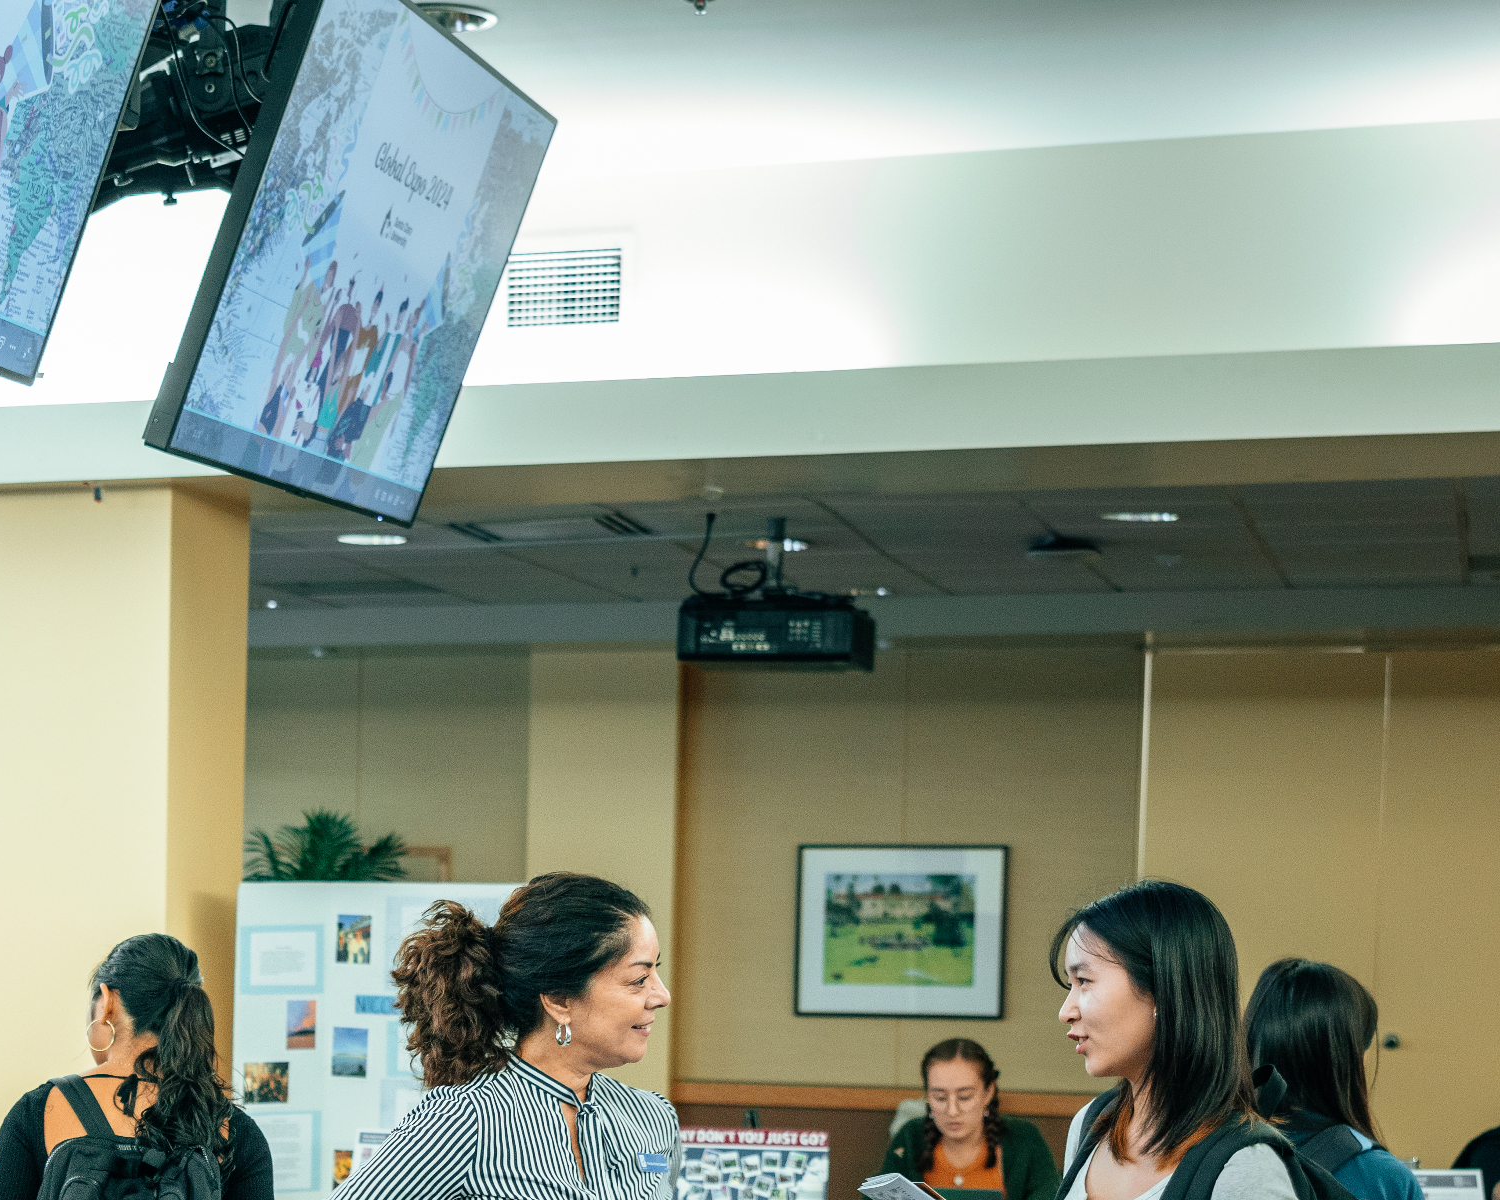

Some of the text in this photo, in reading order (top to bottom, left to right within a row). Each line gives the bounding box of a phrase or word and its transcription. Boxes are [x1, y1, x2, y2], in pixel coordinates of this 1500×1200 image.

[375, 142, 454, 211] Global Expo 2024
[697, 1129, 736, 1143] DON'T
[737, 1130, 765, 1144] YOU
[766, 1131, 798, 1145] JUST
[799, 1131, 828, 1146] GO?
